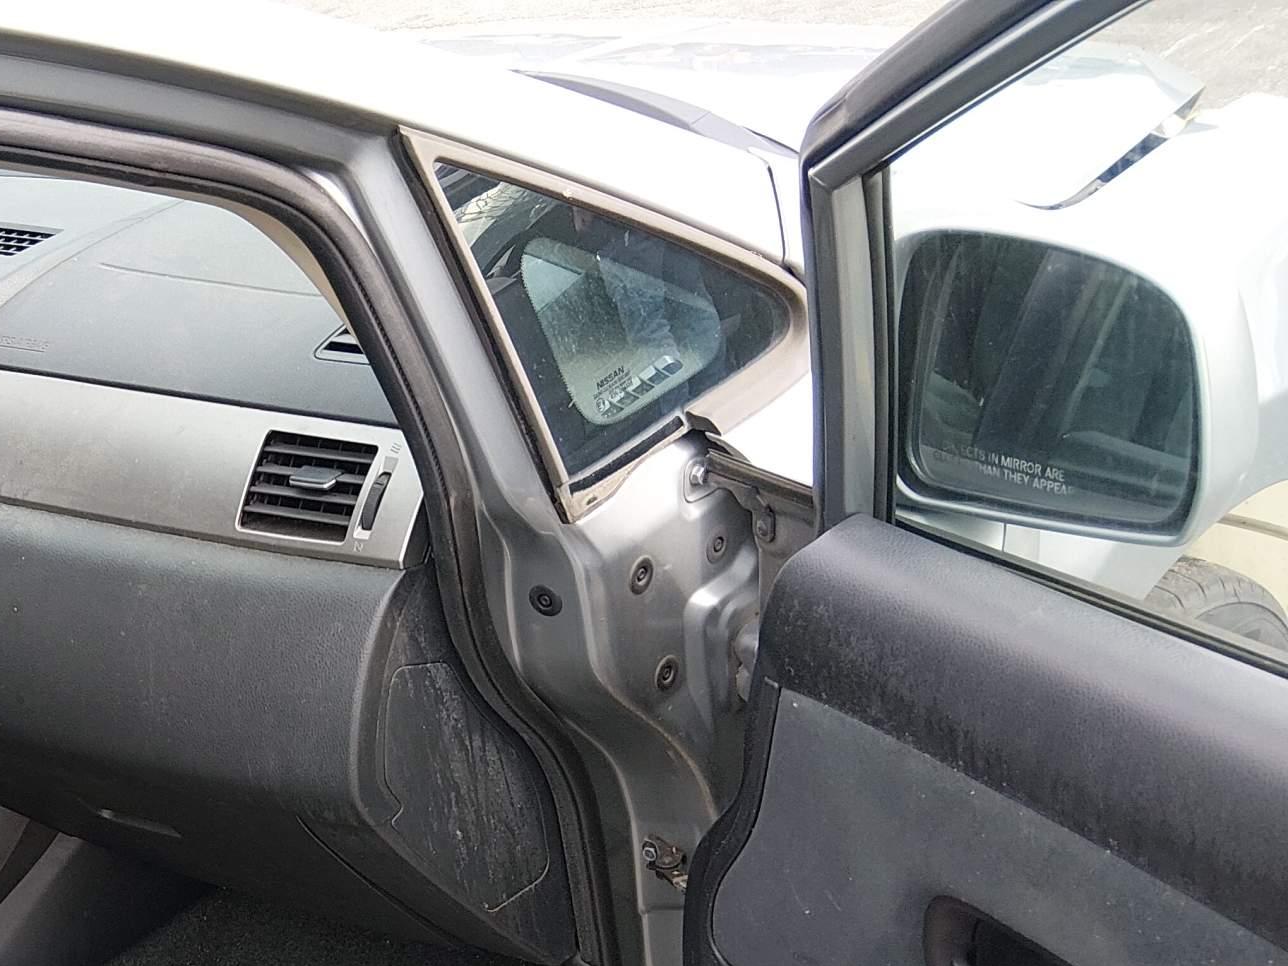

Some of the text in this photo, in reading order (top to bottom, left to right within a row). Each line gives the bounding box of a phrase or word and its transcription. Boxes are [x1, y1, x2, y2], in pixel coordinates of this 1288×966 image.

[596, 366, 625, 390] NISSAN
[1000, 455, 1042, 476] MIRROR
[1044, 466, 1065, 482] ARE
[1002, 468, 1030, 485] THEY
